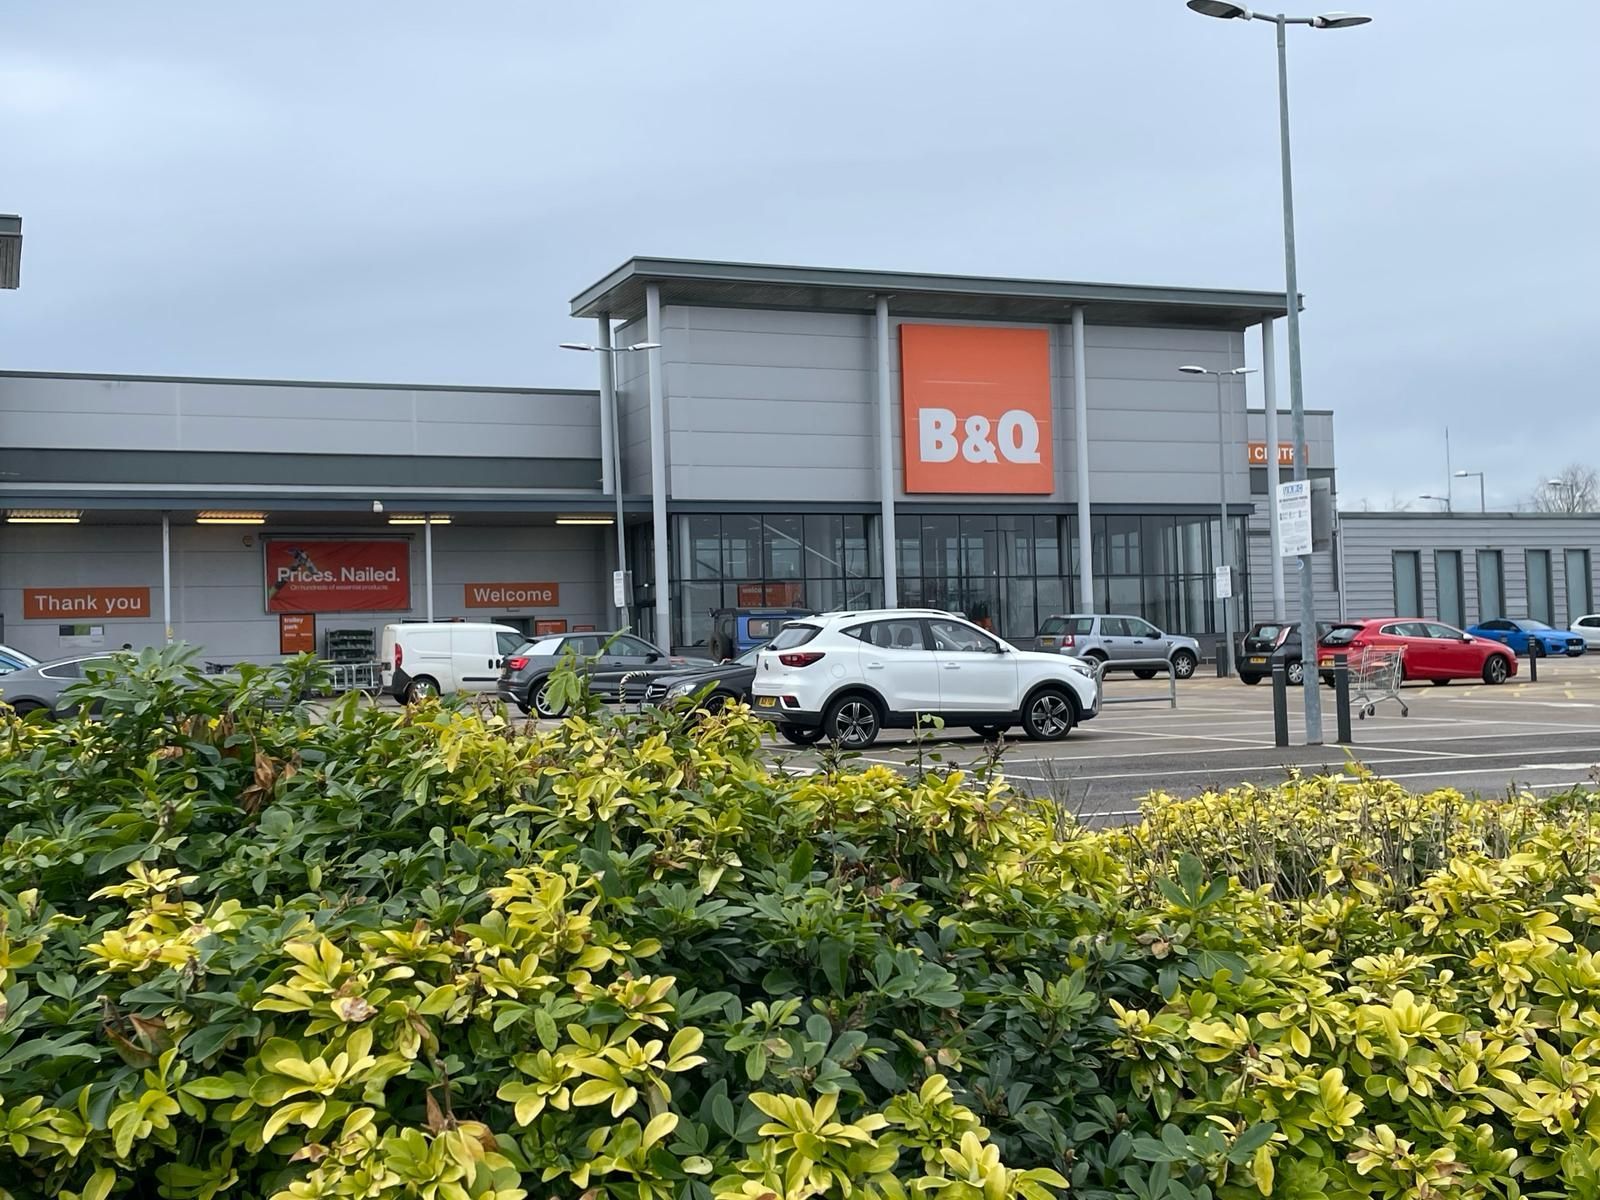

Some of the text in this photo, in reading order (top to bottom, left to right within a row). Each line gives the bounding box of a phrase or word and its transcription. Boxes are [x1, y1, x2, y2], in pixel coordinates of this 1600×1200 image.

[918, 407, 1041, 464] B&Q
[277, 567, 400, 582] Prices. Nailed.
[473, 587, 552, 602] Welcome
[34, 594, 141, 614] Thank you
